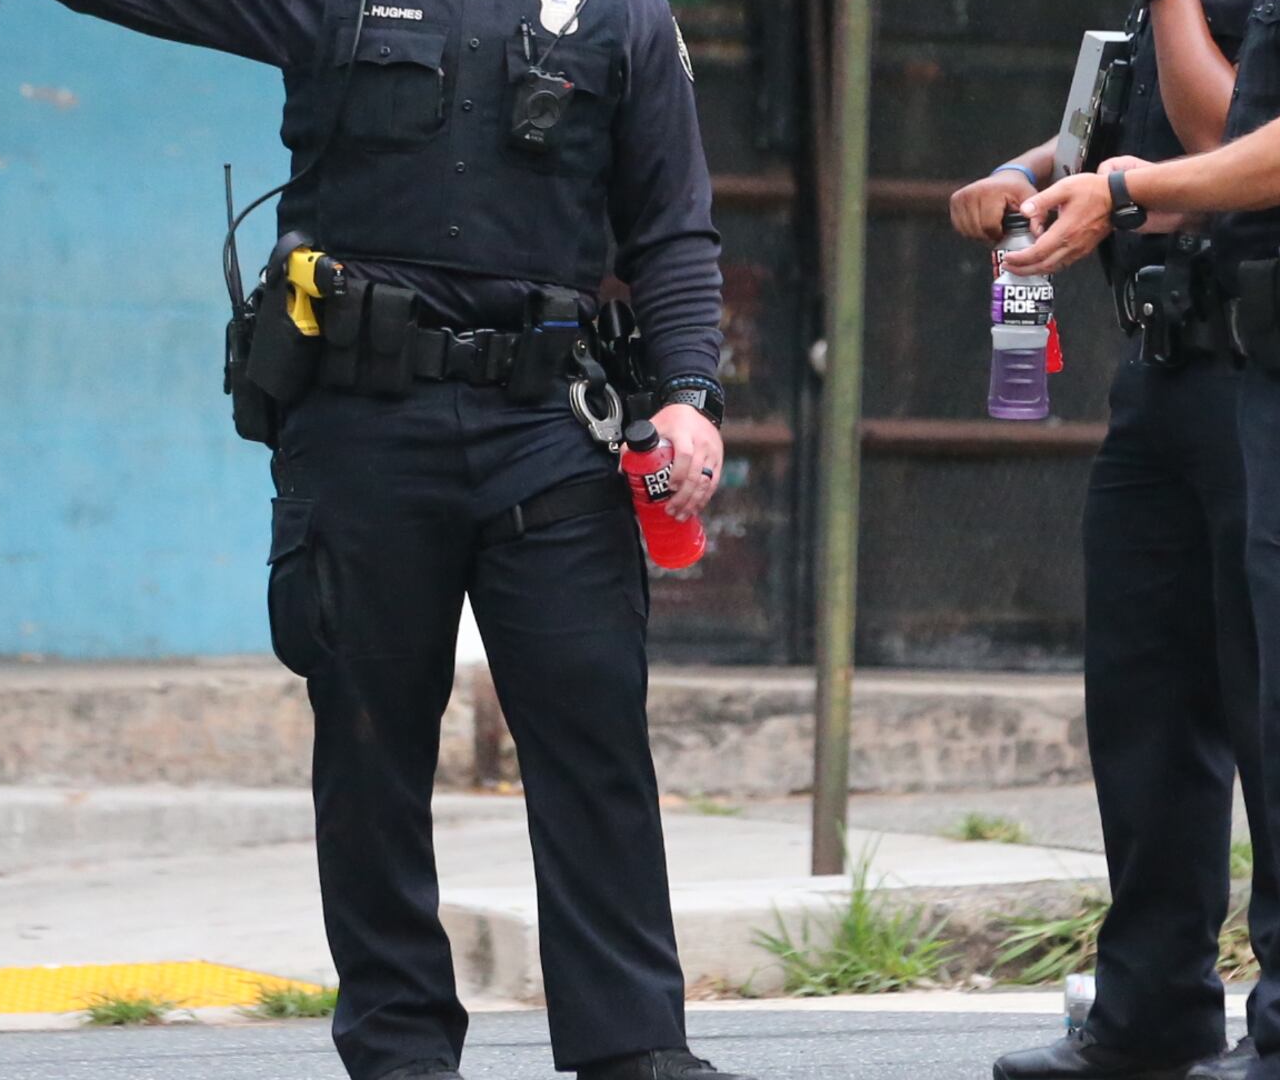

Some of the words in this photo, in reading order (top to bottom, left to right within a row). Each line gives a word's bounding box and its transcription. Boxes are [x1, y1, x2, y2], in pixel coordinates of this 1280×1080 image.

[371, 4, 423, 21] HUGHES
[1004, 285, 1054, 301] POWER
[1003, 300, 1036, 313] ADE
